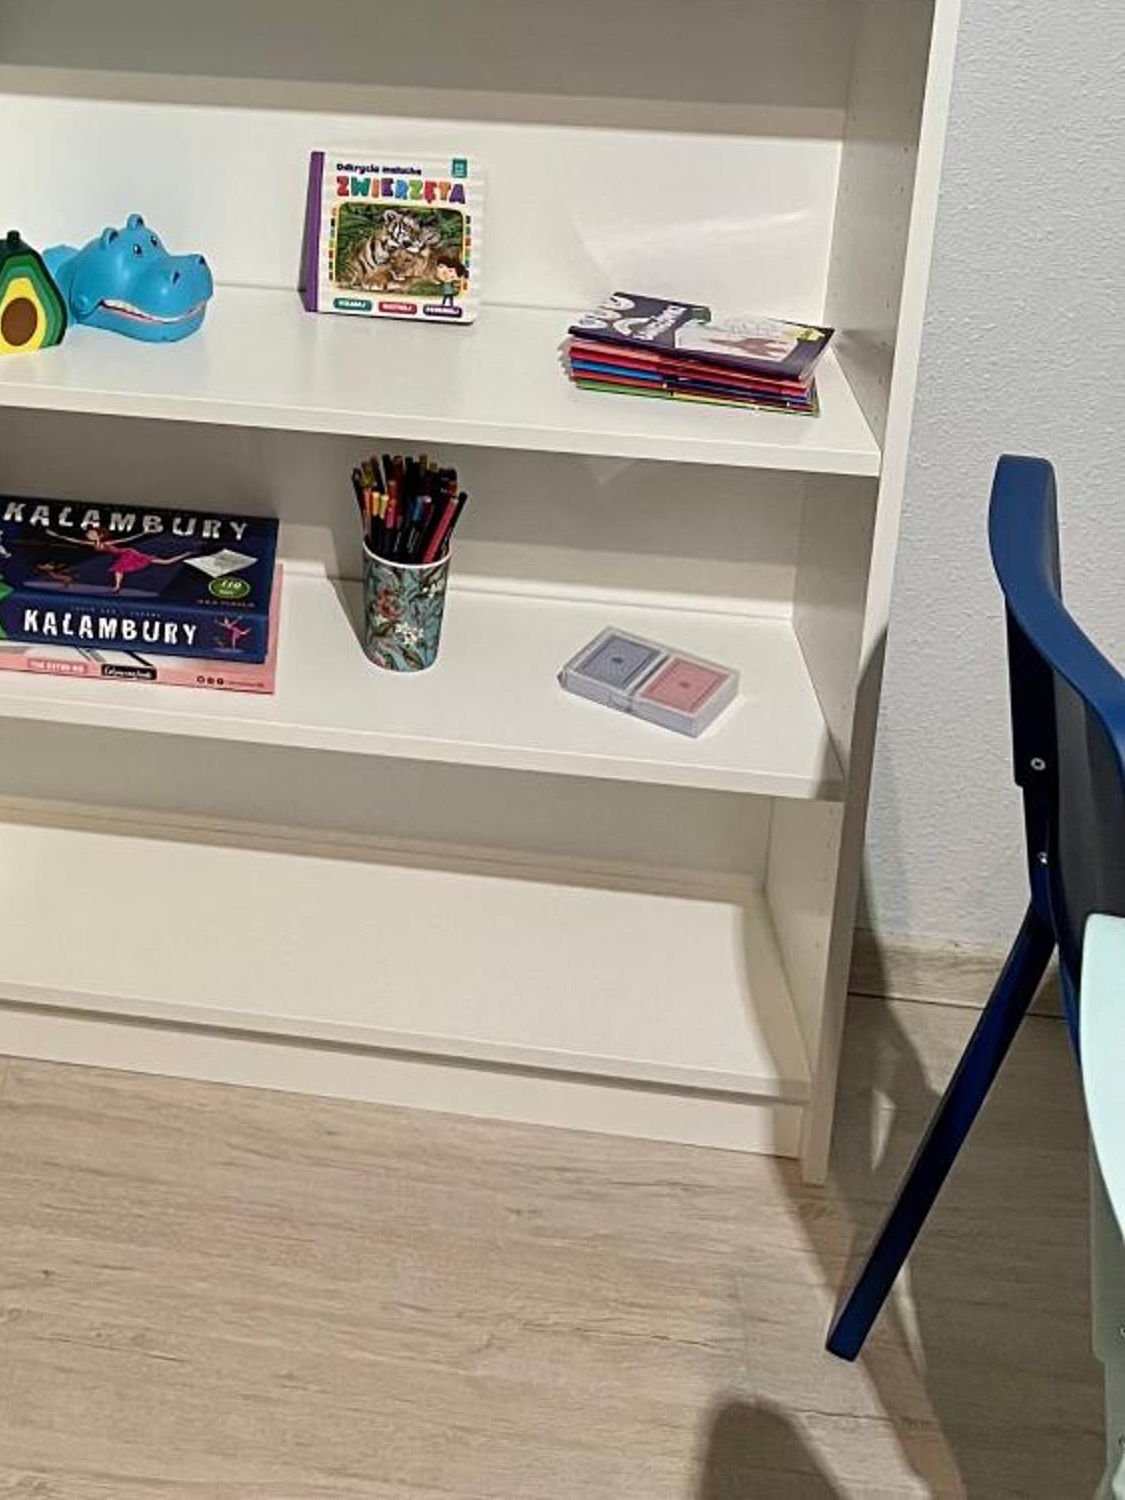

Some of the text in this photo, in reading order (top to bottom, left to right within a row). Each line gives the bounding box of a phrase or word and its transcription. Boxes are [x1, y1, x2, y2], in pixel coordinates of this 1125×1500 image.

[336, 176, 466, 205] ZWIERZĘTA
[3, 501, 248, 541] KALAMBURY
[24, 609, 197, 645] KALAMBURY
